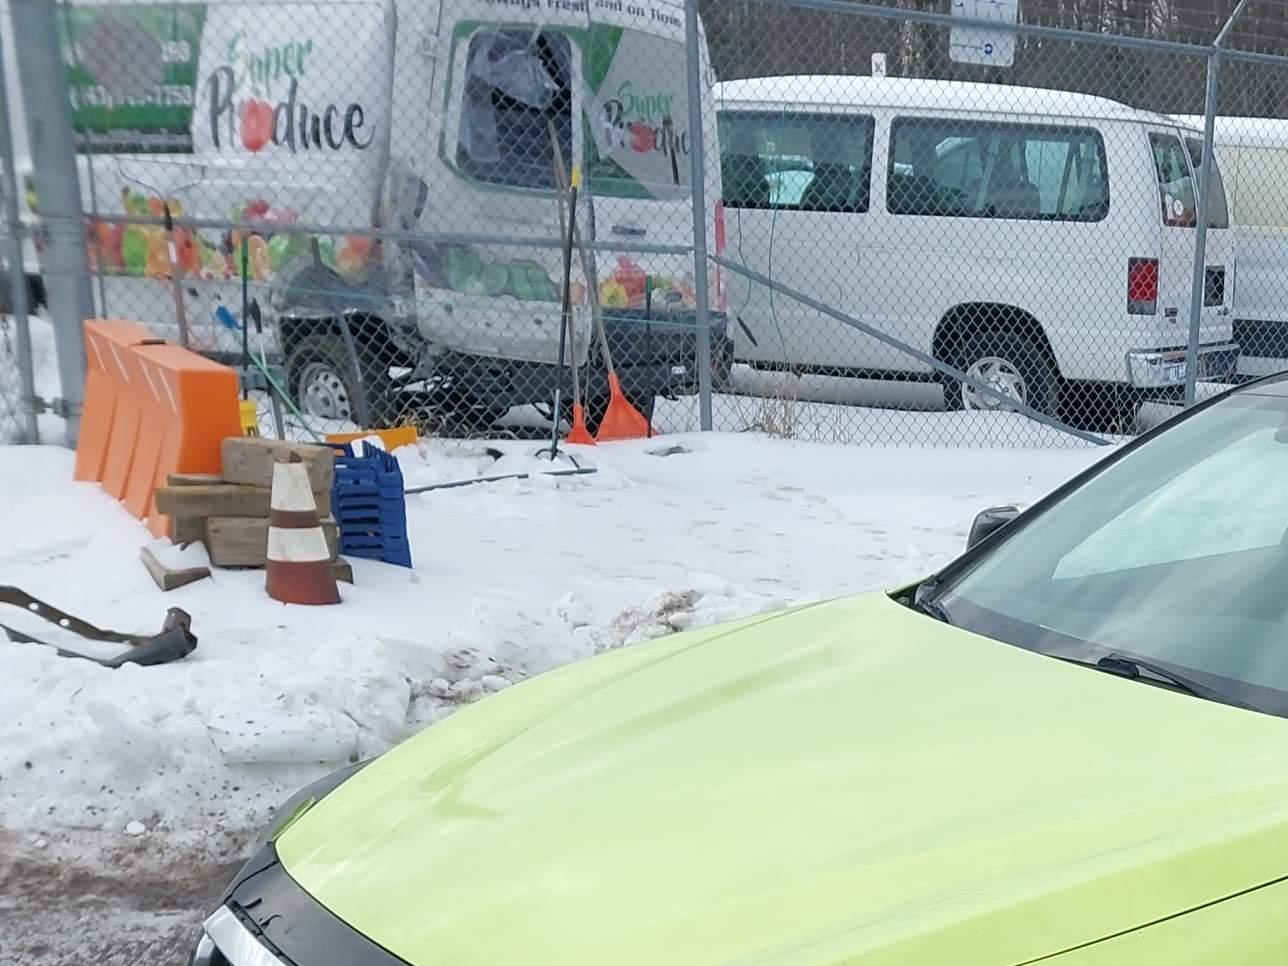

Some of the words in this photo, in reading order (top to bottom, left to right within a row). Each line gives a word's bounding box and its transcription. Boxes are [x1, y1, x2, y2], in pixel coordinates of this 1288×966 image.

[627, 5, 645, 17] on
[227, 28, 313, 98] Super
[617, 80, 673, 121] Super
